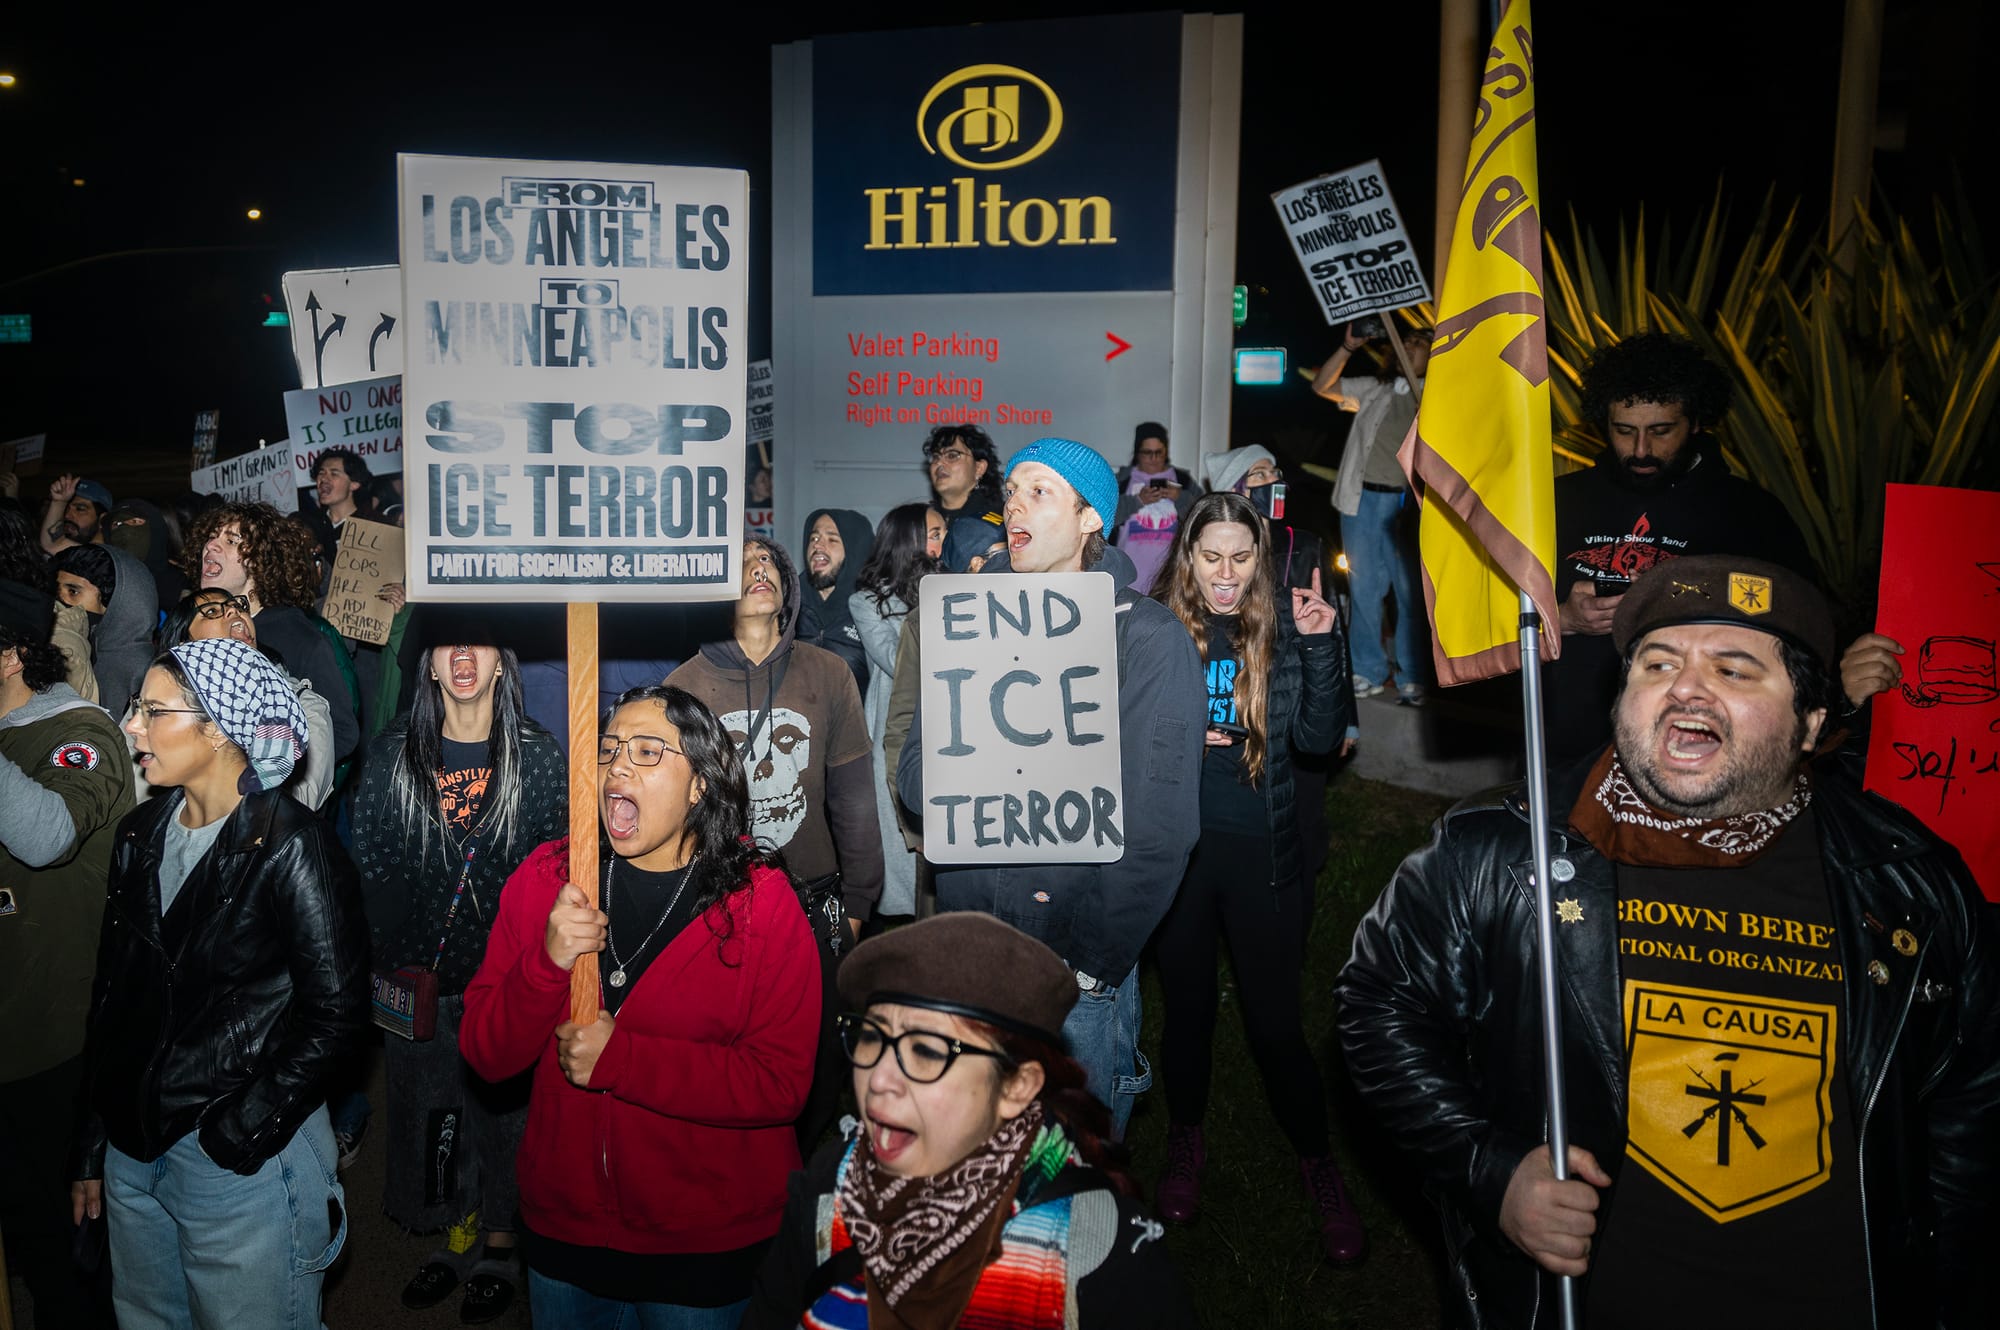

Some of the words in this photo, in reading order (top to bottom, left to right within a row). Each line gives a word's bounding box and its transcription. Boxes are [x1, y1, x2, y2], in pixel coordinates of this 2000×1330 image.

[510, 182, 647, 207] FROM
[1283, 195, 1317, 225] LOS
[1318, 175, 1384, 213] ANGELES
[1305, 179, 1349, 197] FROM
[864, 177, 1117, 250] Hilton
[1296, 209, 1397, 255] MINNEAPOLIS
[1331, 213, 1350, 224] TO
[422, 195, 514, 265] LOS
[525, 202, 731, 271] ANGELES
[1310, 239, 1407, 280] STOP
[547, 282, 612, 305] TO
[1318, 274, 1352, 305] ICE
[1350, 261, 1421, 298] TERROR
[425, 300, 729, 370] MINNEAPOLIS
[849, 332, 905, 357] Valet
[912, 331, 999, 362] Parking
[319, 390, 351, 416] NO
[848, 371, 890, 396] Self
[898, 371, 983, 401] Parking
[302, 422, 326, 445] IS
[343, 411, 403, 437] ILLEG
[426, 400, 731, 455] STOP
[846, 404, 893, 427] Right
[897, 408, 920, 424] on
[925, 404, 991, 425] Golden
[996, 404, 1053, 425] Shore
[211, 449, 289, 490] IMMIGRANTS
[429, 464, 511, 538] ICE
[524, 465, 729, 539] TERROR
[343, 521, 383, 551] ALL
[1624, 533, 1656, 544] Show
[336, 550, 379, 577] COPS
[431, 552, 485, 577] PARTY
[486, 552, 519, 577] FOR
[520, 552, 608, 577] SOCIALISM
[610, 553, 631, 577] &
[634, 552, 724, 578] LIBERATION
[1575, 562, 1596, 576] Long
[942, 588, 1082, 641] END
[932, 666, 1105, 757] ICE
[929, 786, 1125, 849] TERROR
[1739, 912, 1836, 949] BERE
[1645, 997, 1685, 1025] LA
[1703, 1006, 1815, 1044] CAUSA
